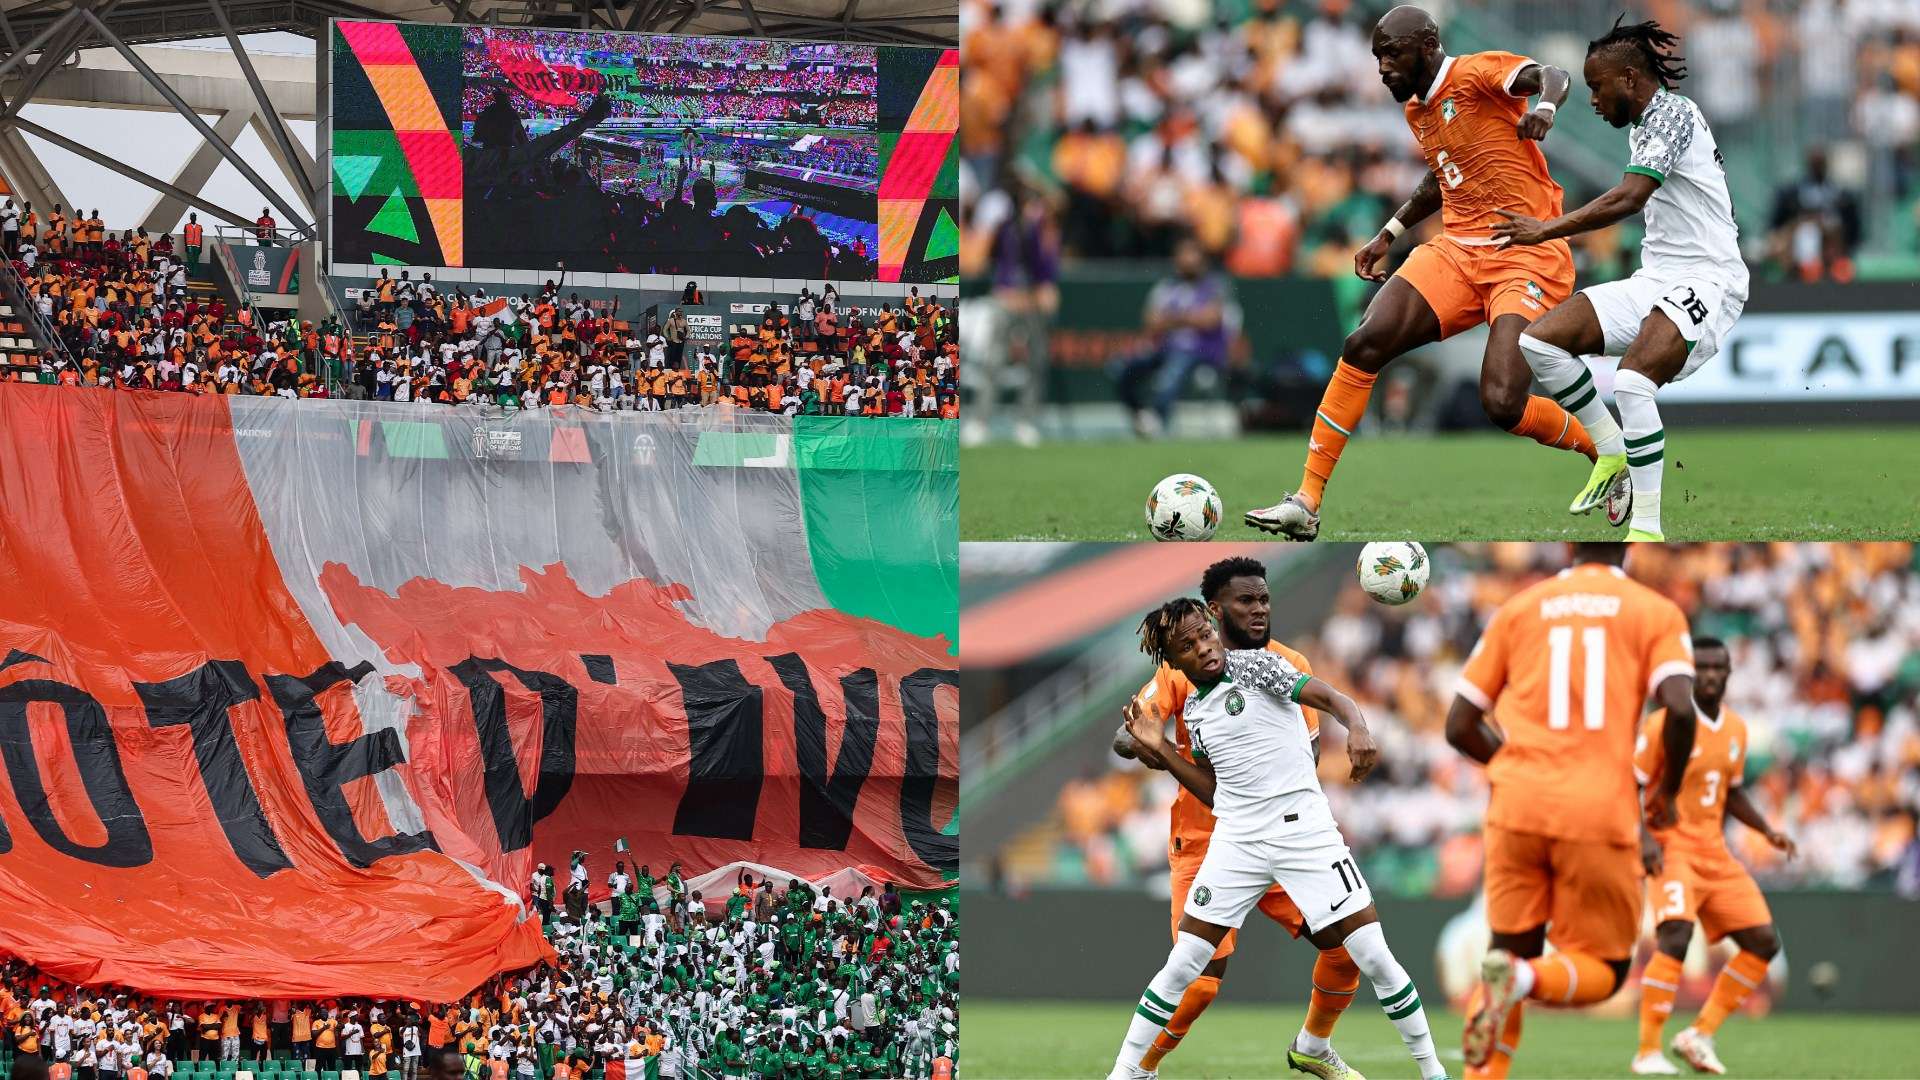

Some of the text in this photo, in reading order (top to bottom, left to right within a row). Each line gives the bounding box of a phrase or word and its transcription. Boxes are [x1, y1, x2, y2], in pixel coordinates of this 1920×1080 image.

[1437, 151, 1463, 189] 6
[869, 308, 909, 317] NAION
[1682, 287, 1708, 326] 18
[1730, 335, 1920, 380] CAF
[1549, 625, 1606, 729] 11
[1700, 770, 1721, 807] 3
[1331, 858, 1362, 893] 11
[1664, 880, 1685, 916] 3
